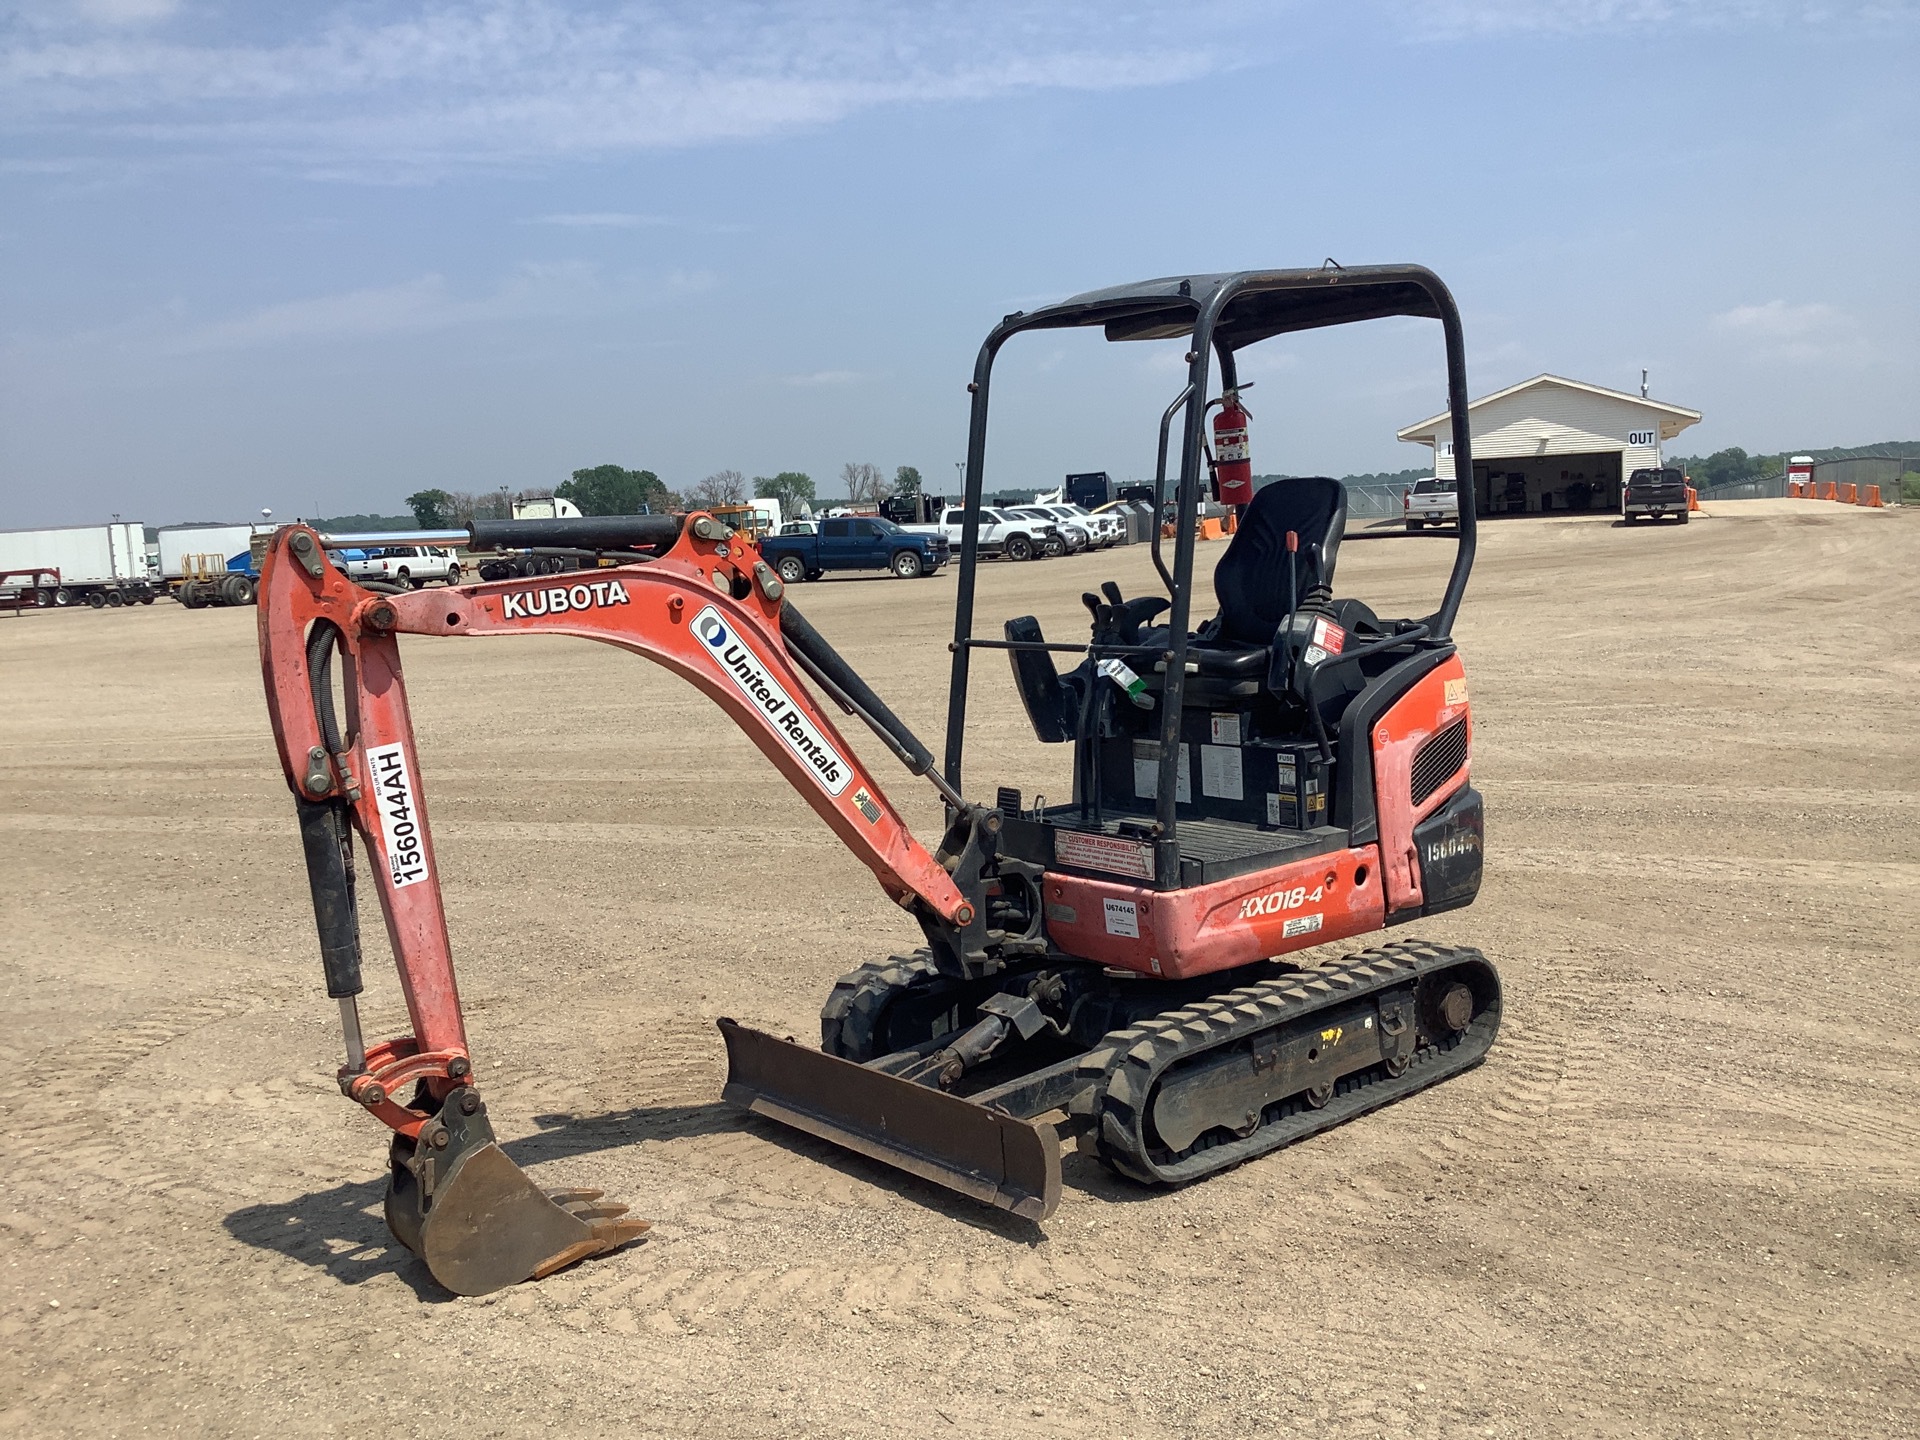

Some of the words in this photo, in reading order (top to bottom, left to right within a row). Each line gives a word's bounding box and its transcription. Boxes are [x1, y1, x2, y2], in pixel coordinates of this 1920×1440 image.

[1629, 432, 1654, 445] OUT
[503, 580, 629, 619] KUBOTA
[723, 645, 786, 715] United
[777, 709, 841, 784] Rentals
[1278, 754, 1293, 763] FUSE
[378, 751, 423, 881] 156044AH
[1068, 835, 1096, 846] CUSTOMER
[1096, 840, 1139, 853] RESPONSIBILITY
[1105, 903, 1135, 915] U674145
[1238, 885, 1324, 920] KX018-4
